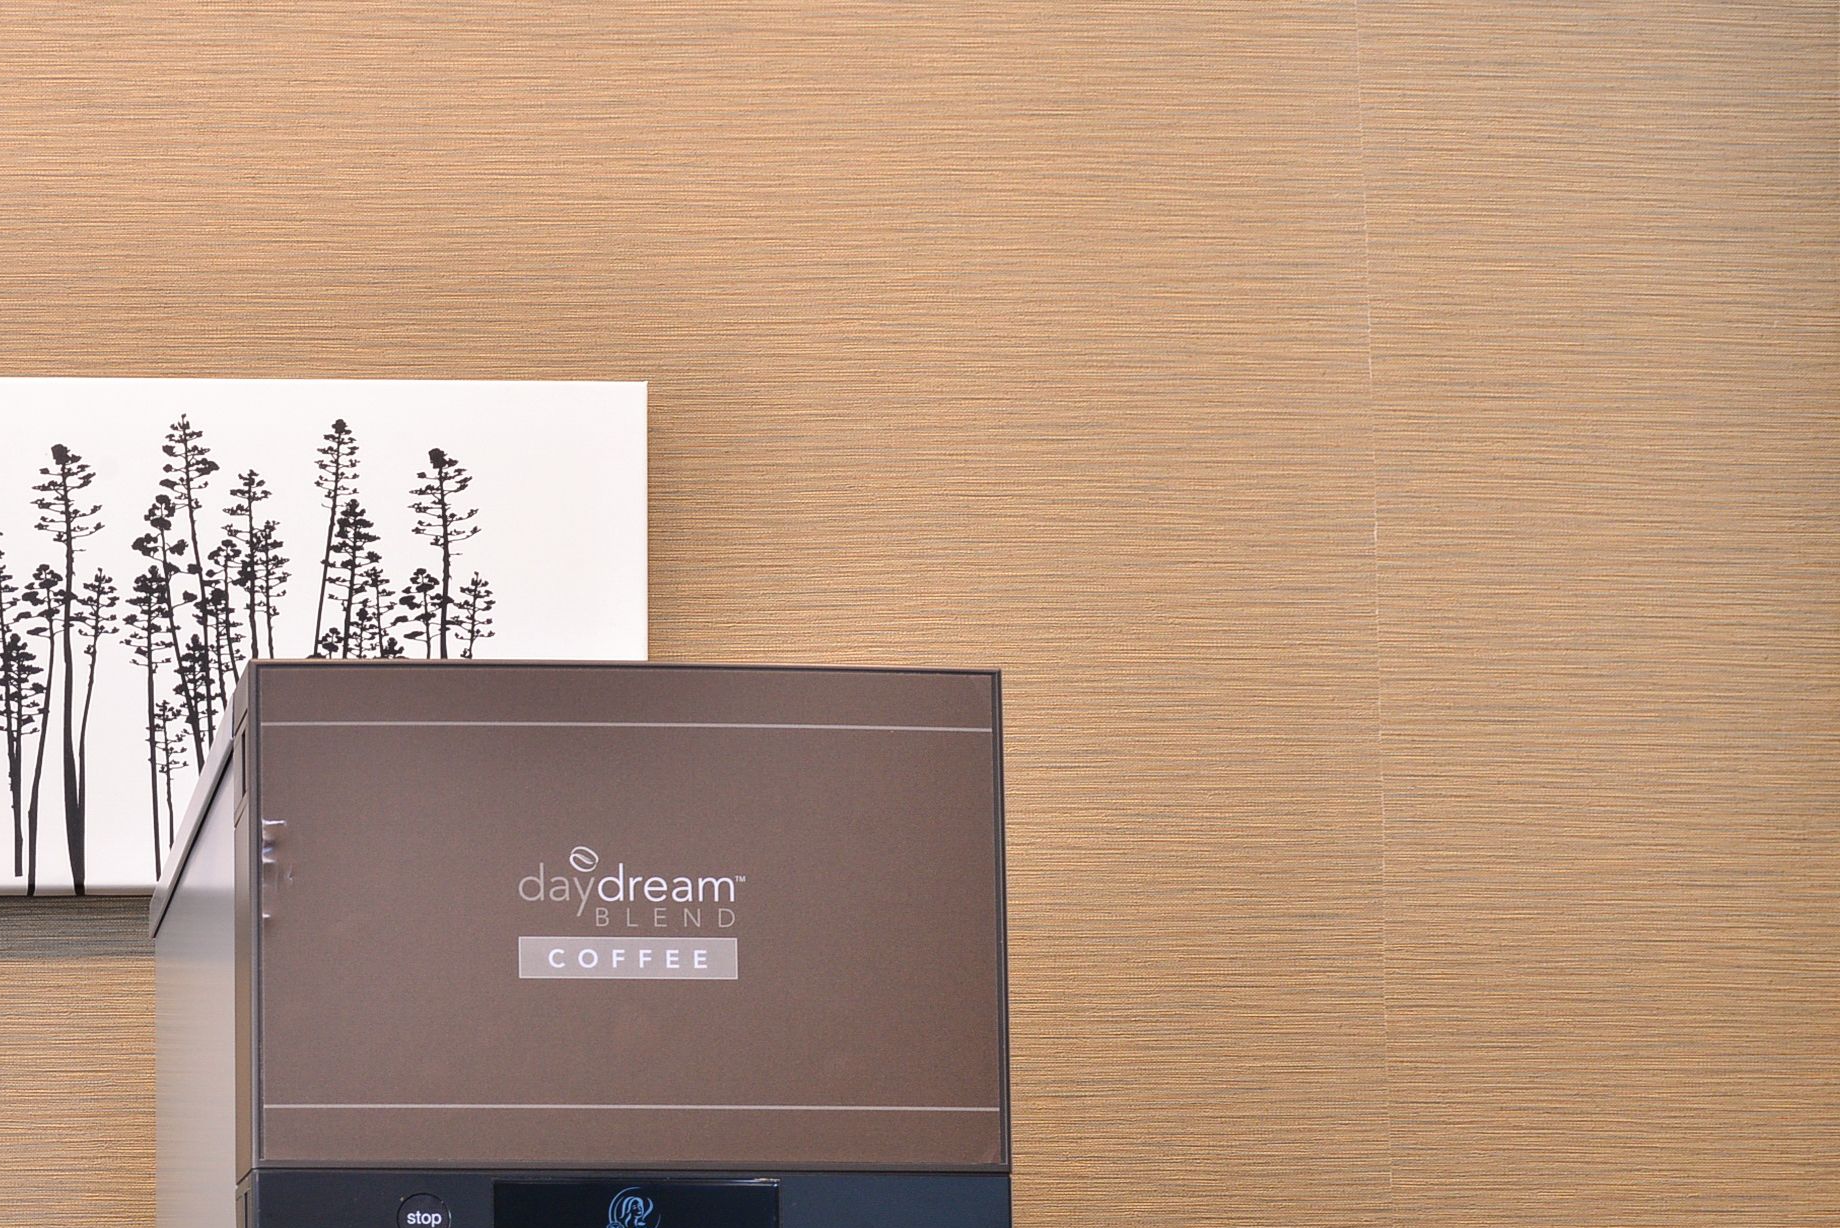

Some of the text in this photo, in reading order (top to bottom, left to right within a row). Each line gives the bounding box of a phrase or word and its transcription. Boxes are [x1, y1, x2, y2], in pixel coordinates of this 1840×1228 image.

[595, 907, 736, 928] BLEND
[548, 948, 708, 969] COFFEE
[407, 1210, 442, 1228] stop
